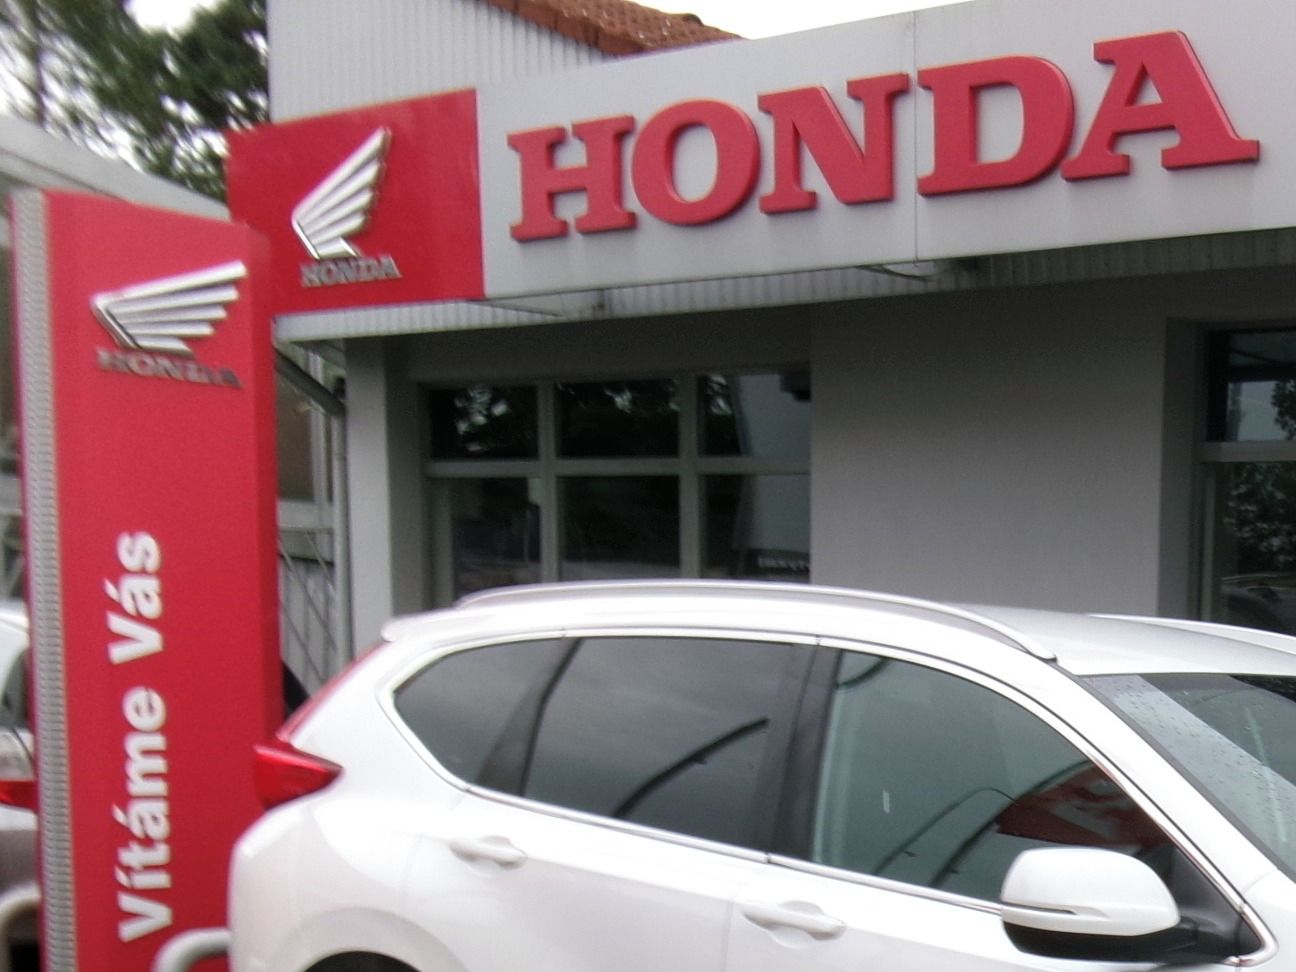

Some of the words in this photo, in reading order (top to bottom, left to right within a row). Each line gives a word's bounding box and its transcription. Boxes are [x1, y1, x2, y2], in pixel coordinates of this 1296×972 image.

[507, 30, 1260, 242] HONDA
[300, 254, 402, 288] HONDA
[96, 347, 243, 389] HONDA
[105, 531, 164, 664] Vás
[112, 686, 173, 942] Vítáme
